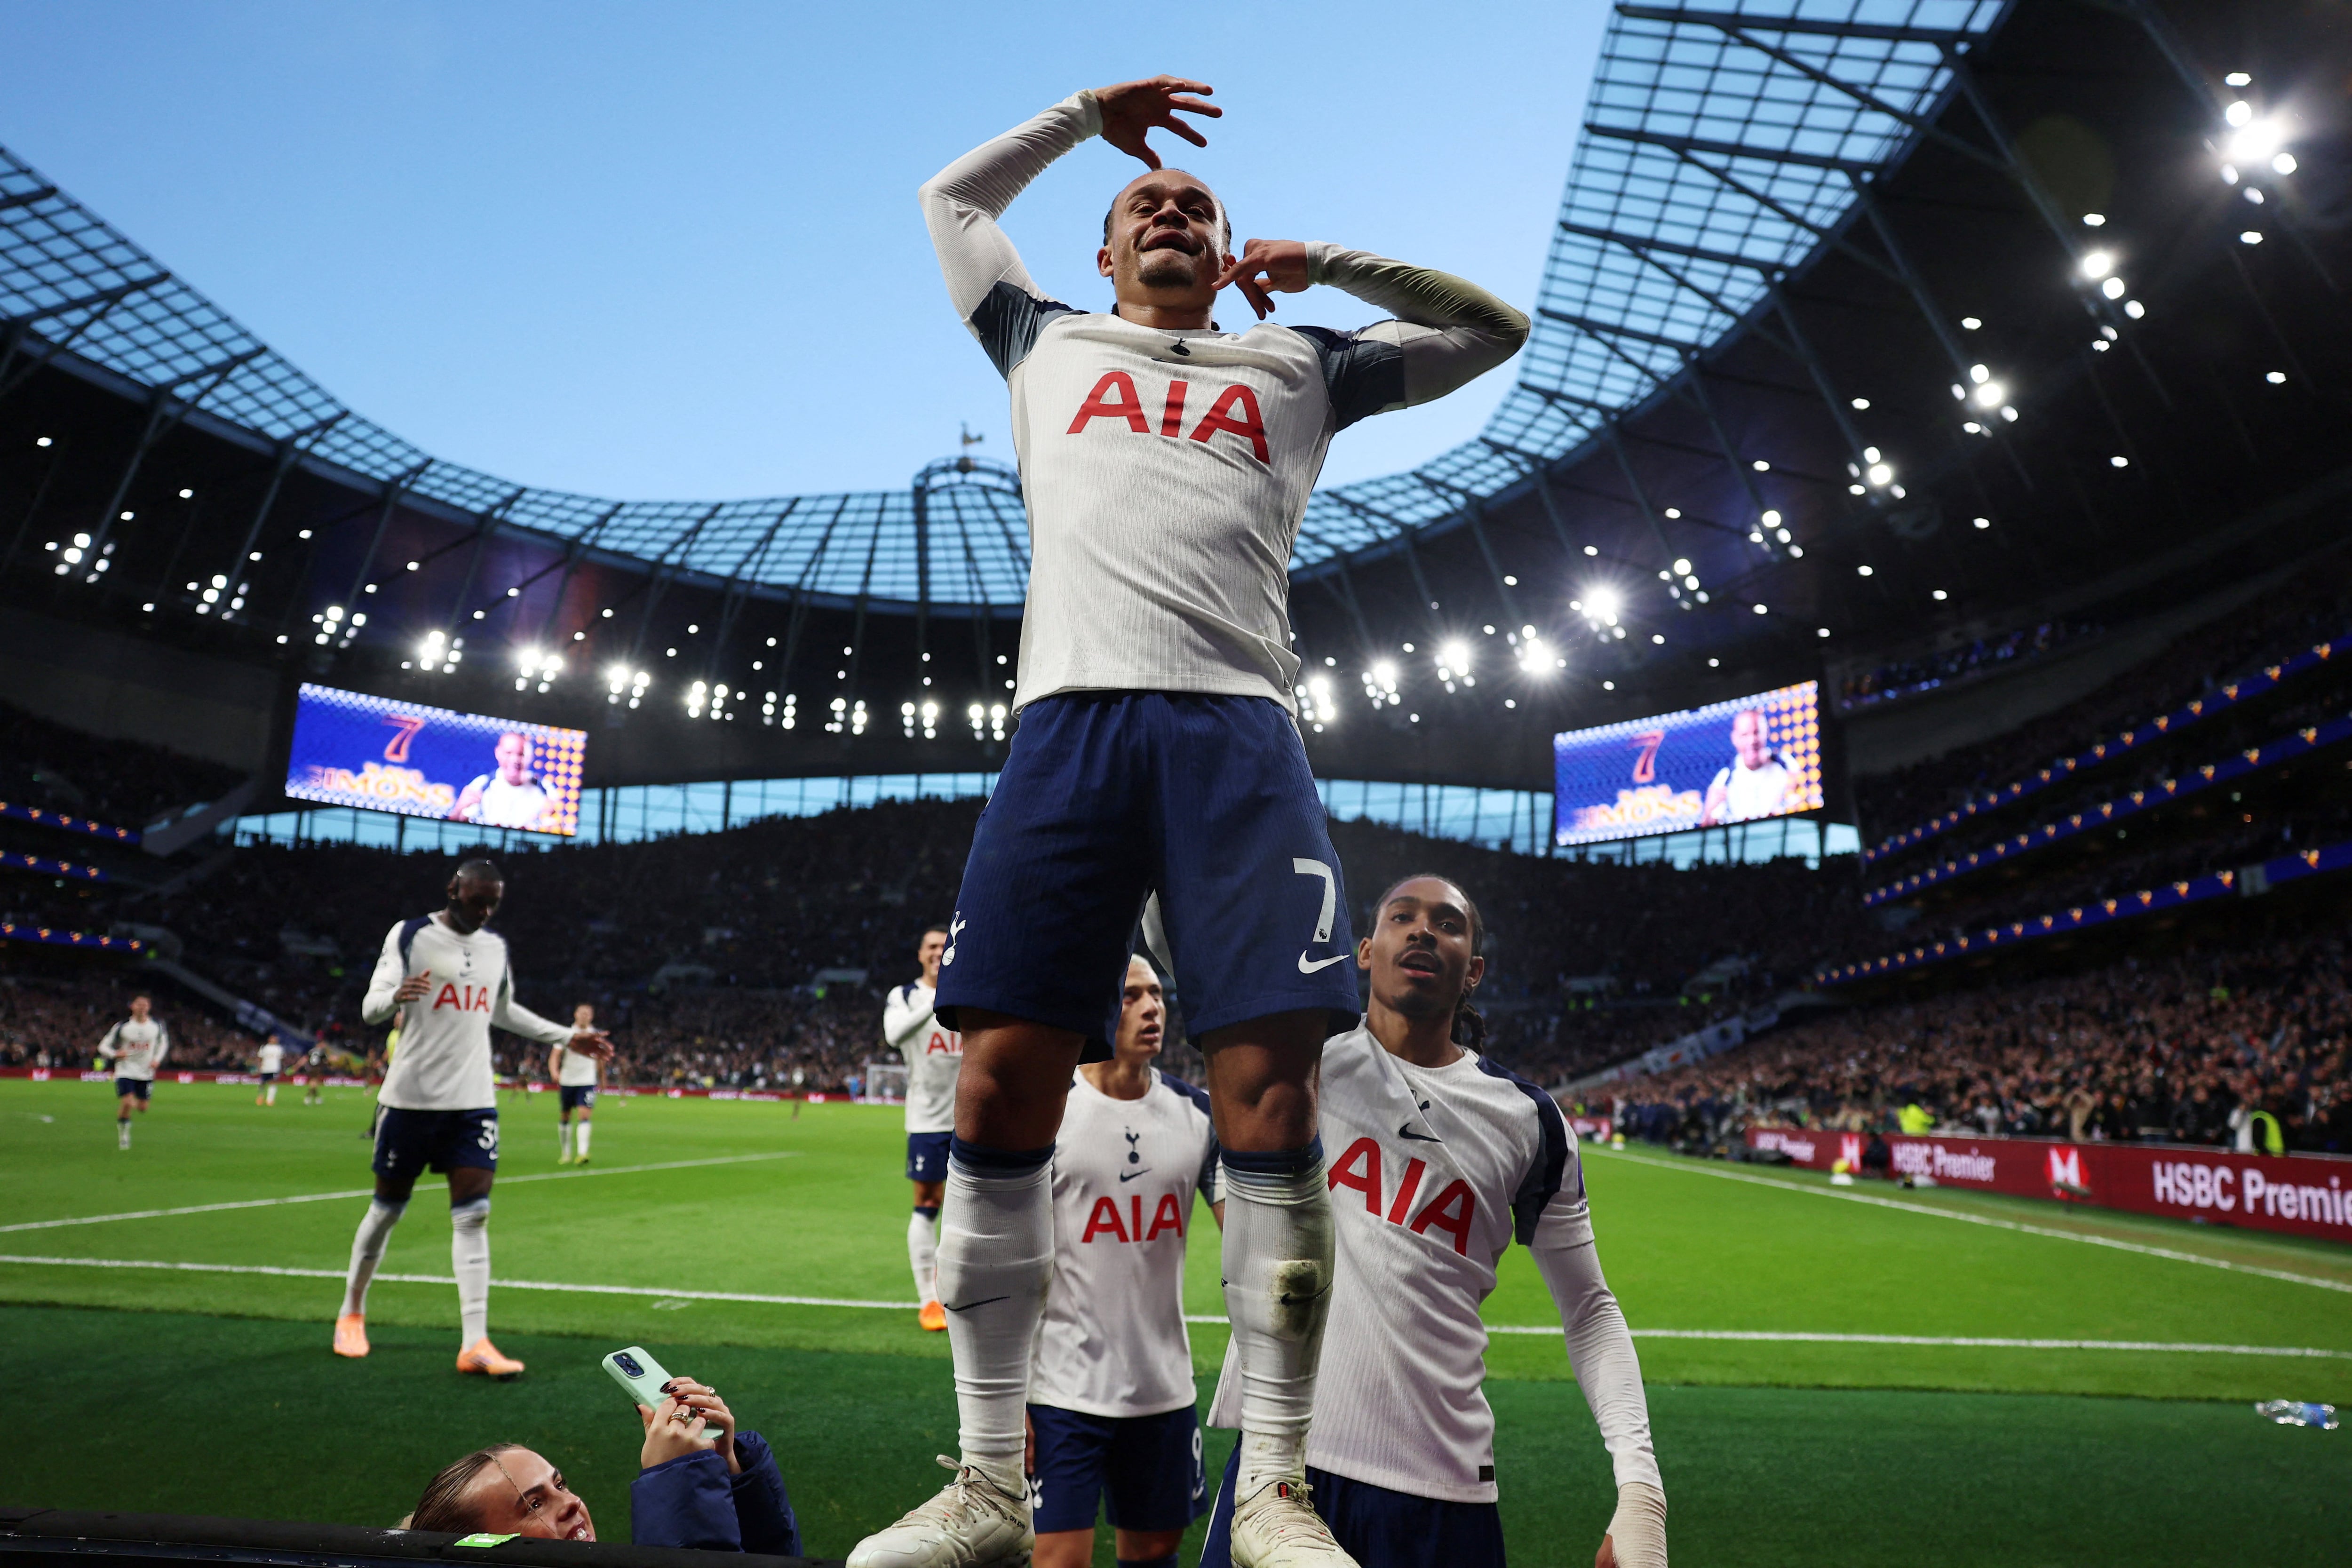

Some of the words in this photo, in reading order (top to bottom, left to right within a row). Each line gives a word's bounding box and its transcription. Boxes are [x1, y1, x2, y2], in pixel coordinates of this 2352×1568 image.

[1066, 371, 1271, 465] AIA
[381, 713, 425, 763] 7
[1627, 730, 1664, 783] 7
[307, 765, 455, 808] SIMONS
[1293, 858, 1336, 943] 7
[433, 983, 490, 1013] AIA
[926, 1031, 963, 1055] AI
[1933, 1144, 1996, 1182] Premier
[2153, 1161, 2236, 1211] HSBC
[1081, 1194, 1183, 1243] AIA
[1327, 1137, 1475, 1257] AIA
[1192, 1427, 1203, 1479] 9
